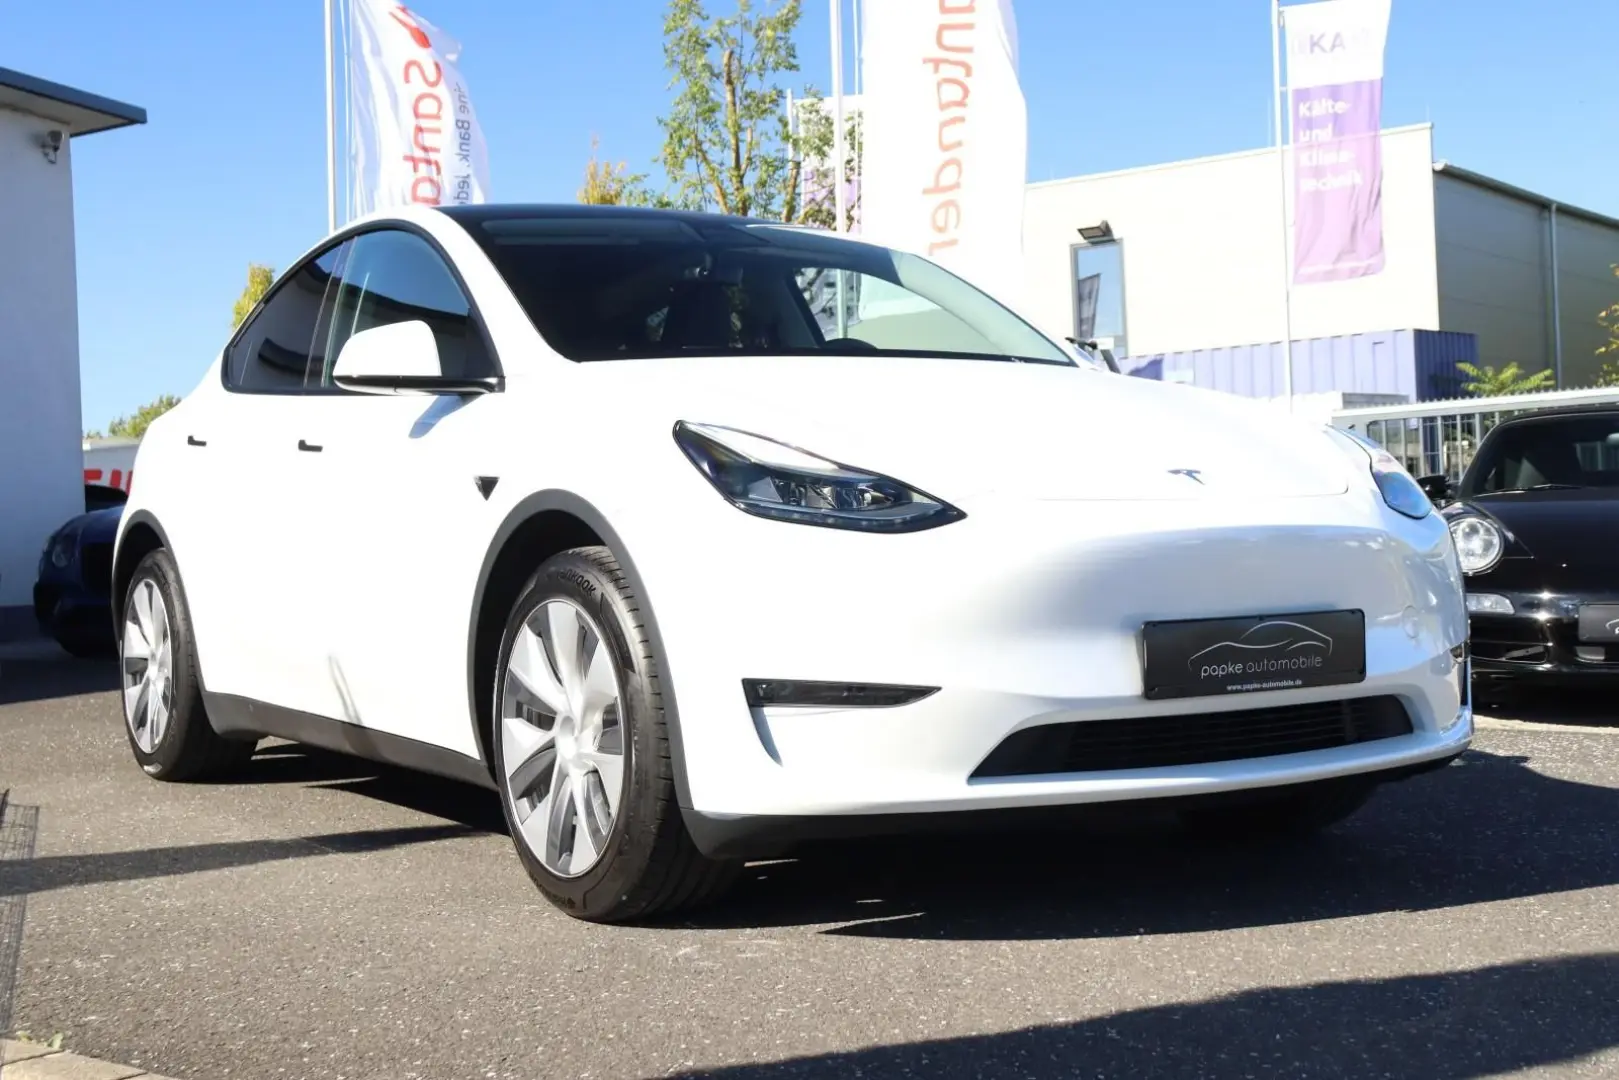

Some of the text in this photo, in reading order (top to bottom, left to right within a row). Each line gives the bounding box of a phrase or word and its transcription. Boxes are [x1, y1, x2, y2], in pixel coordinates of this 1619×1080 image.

[1200, 655, 1323, 680] papke automobile
[1226, 679, 1303, 691] www.papke-automobile.de
